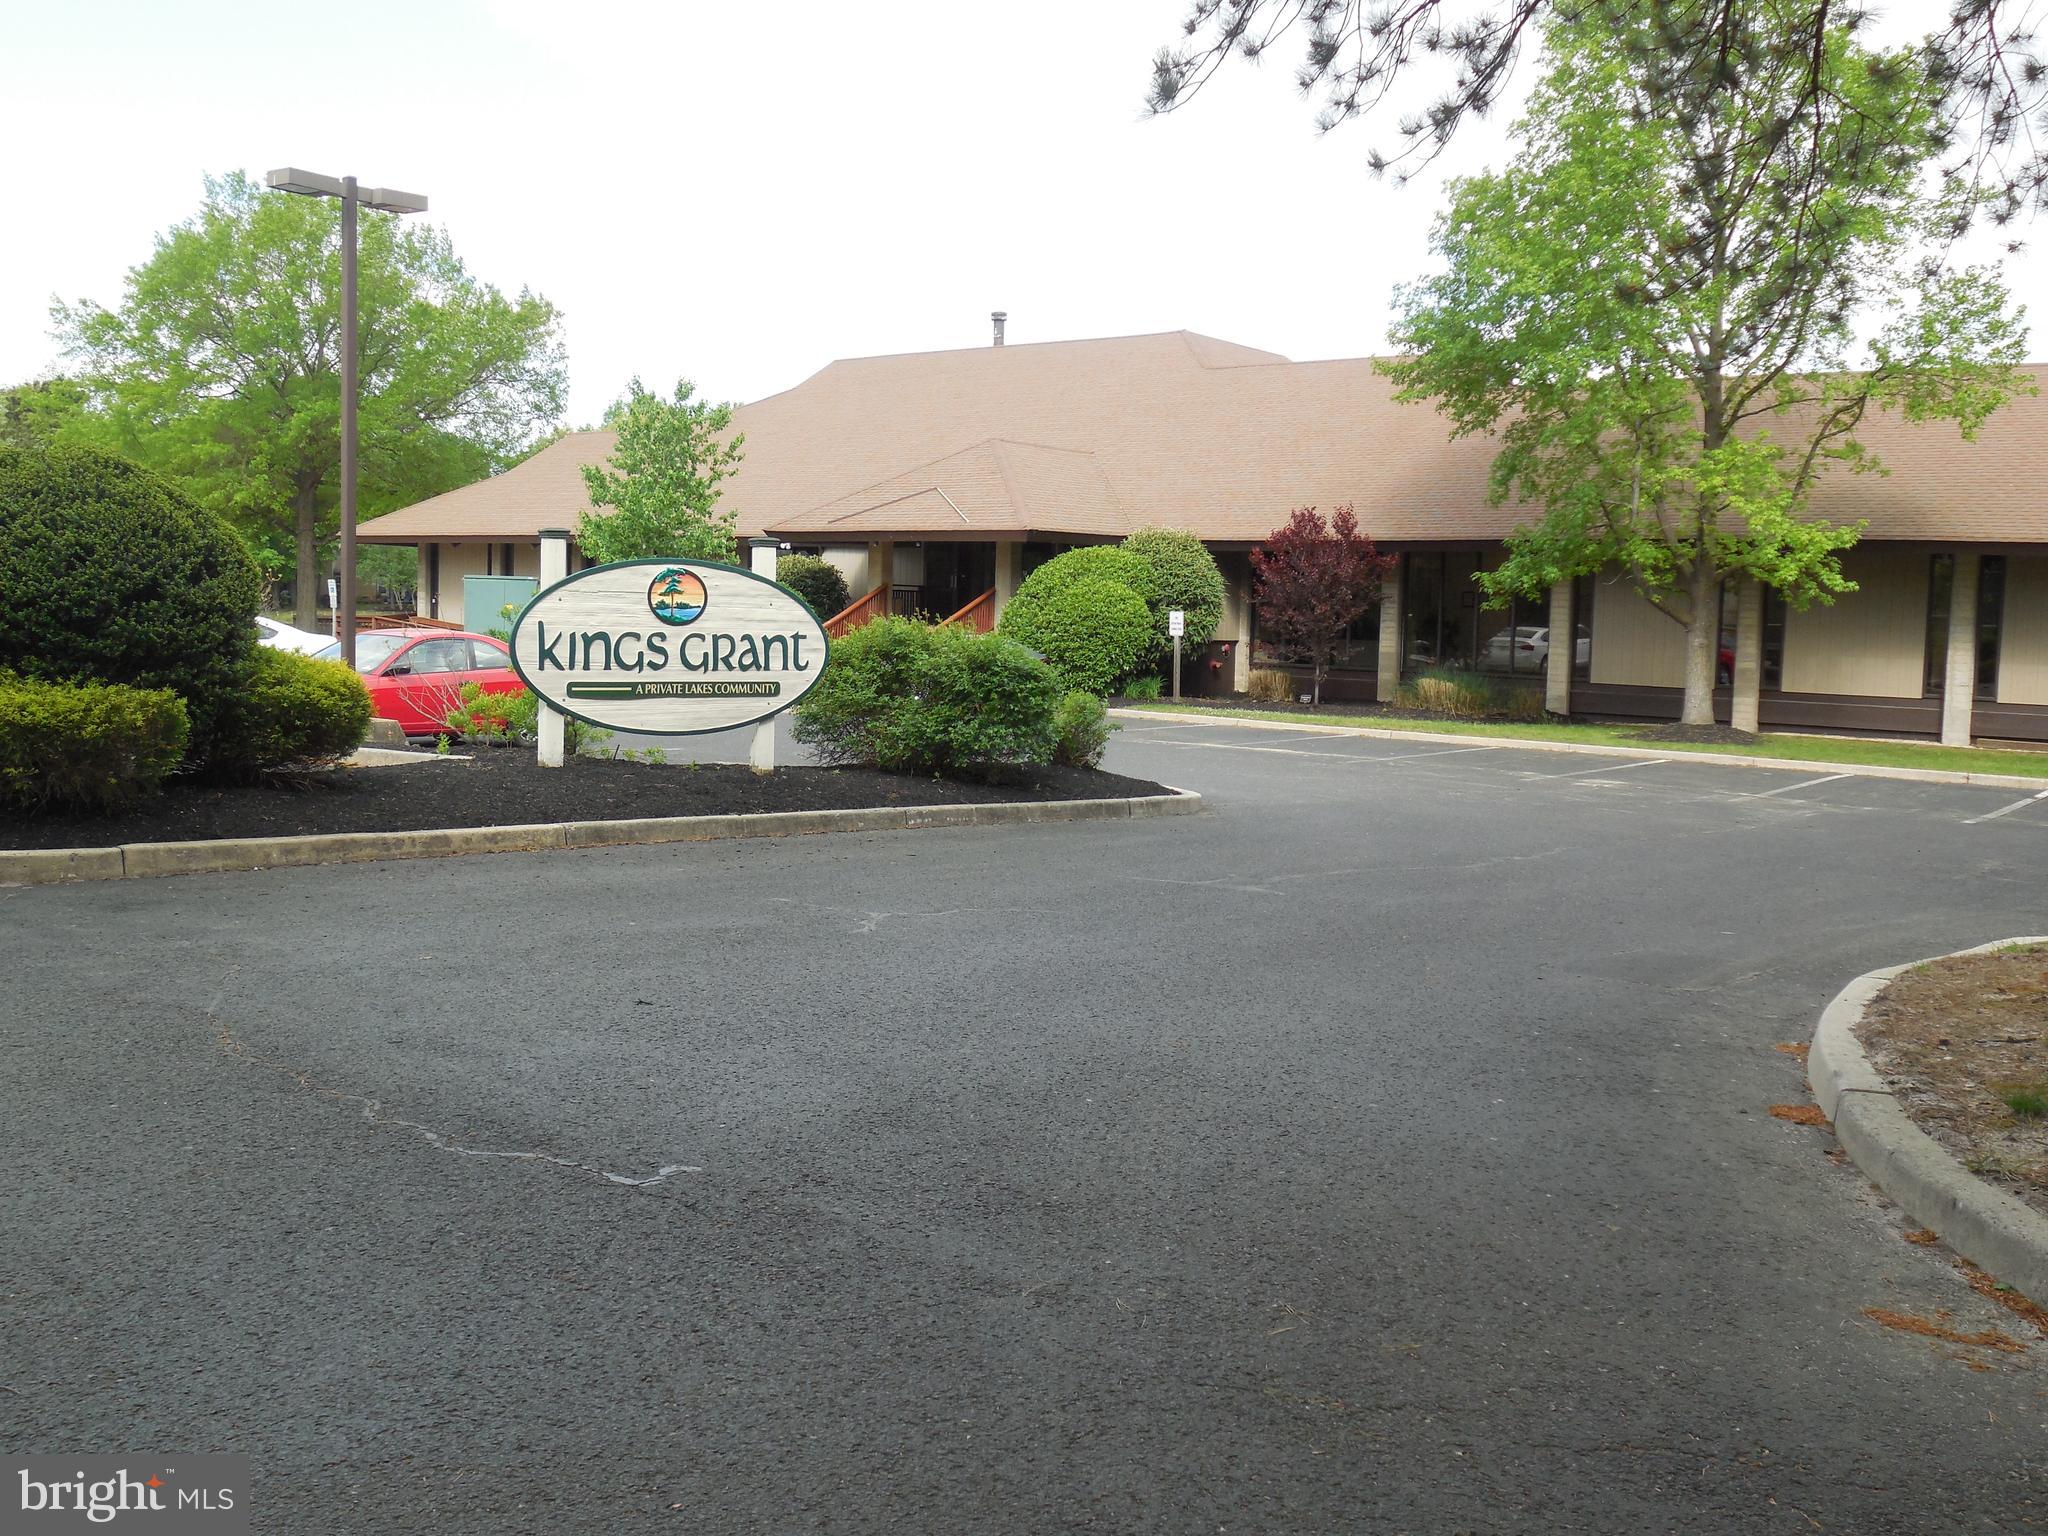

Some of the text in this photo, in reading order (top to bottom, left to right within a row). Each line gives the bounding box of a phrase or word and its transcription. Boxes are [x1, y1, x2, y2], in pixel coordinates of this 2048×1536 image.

[636, 683, 777, 695] A PRIVATE LAKES COMMUNITY
